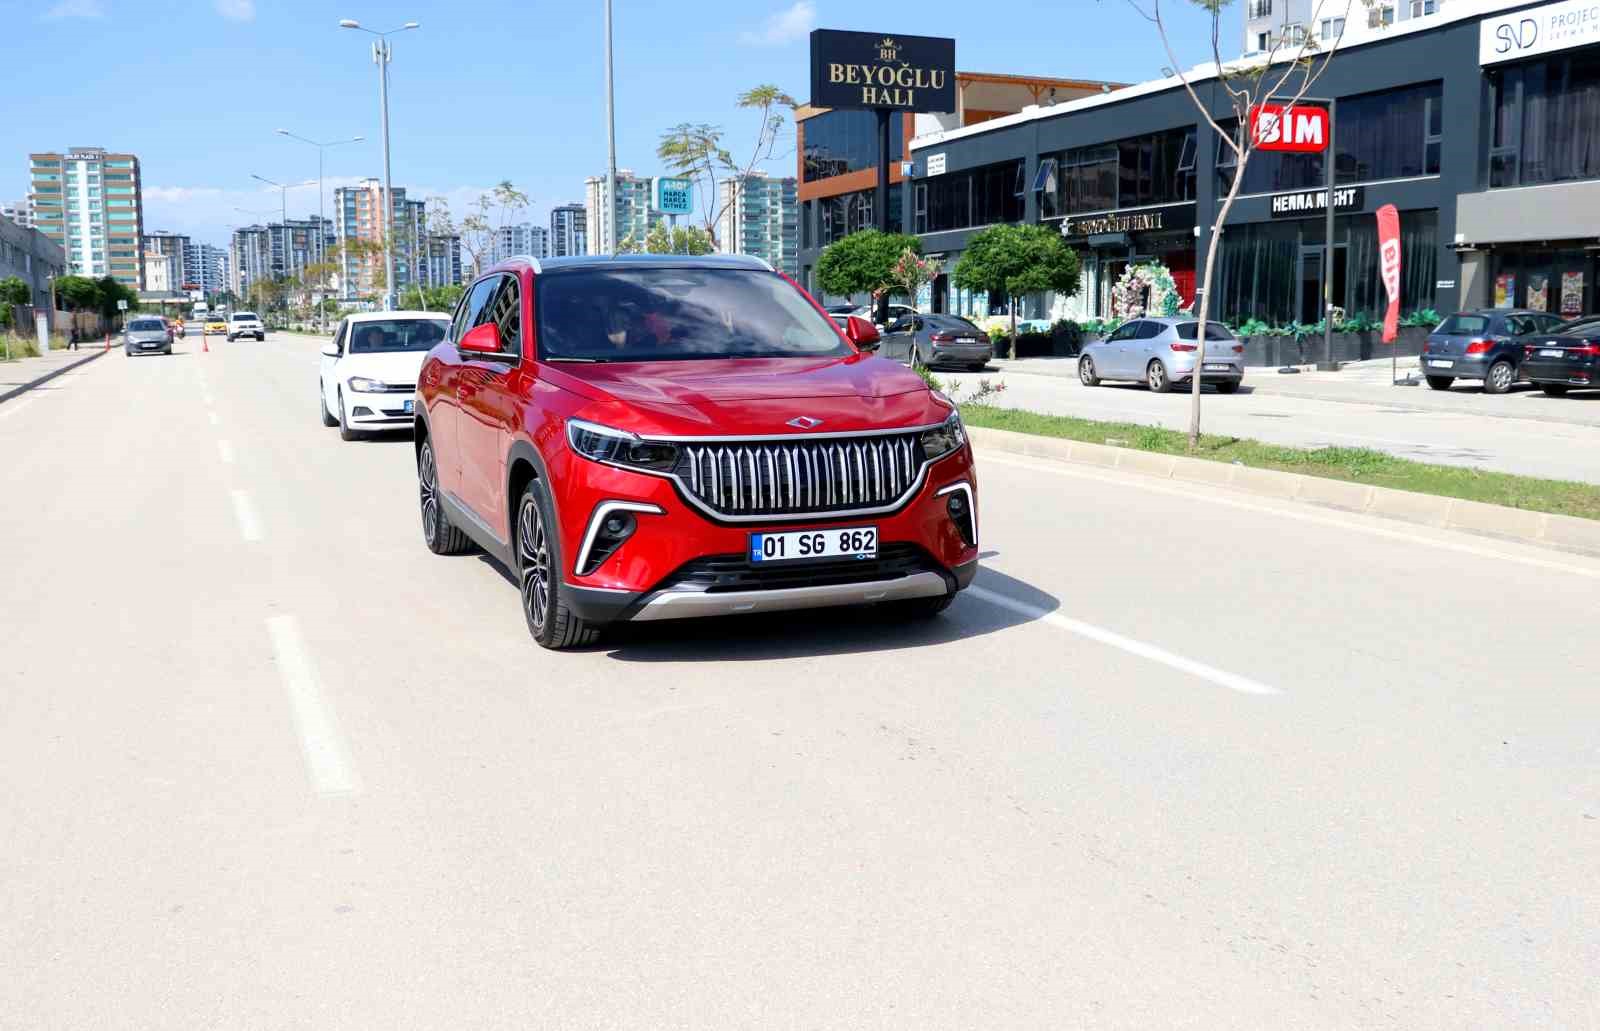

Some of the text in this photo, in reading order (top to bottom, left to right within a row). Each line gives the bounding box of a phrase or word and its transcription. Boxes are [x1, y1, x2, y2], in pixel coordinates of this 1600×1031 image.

[880, 48, 896, 60] BH
[829, 63, 945, 89] BEYOĞLU
[1273, 194, 1314, 212] HENNA
[764, 536, 785, 557] 01
[799, 533, 825, 555] SG
[839, 530, 875, 552] 862
